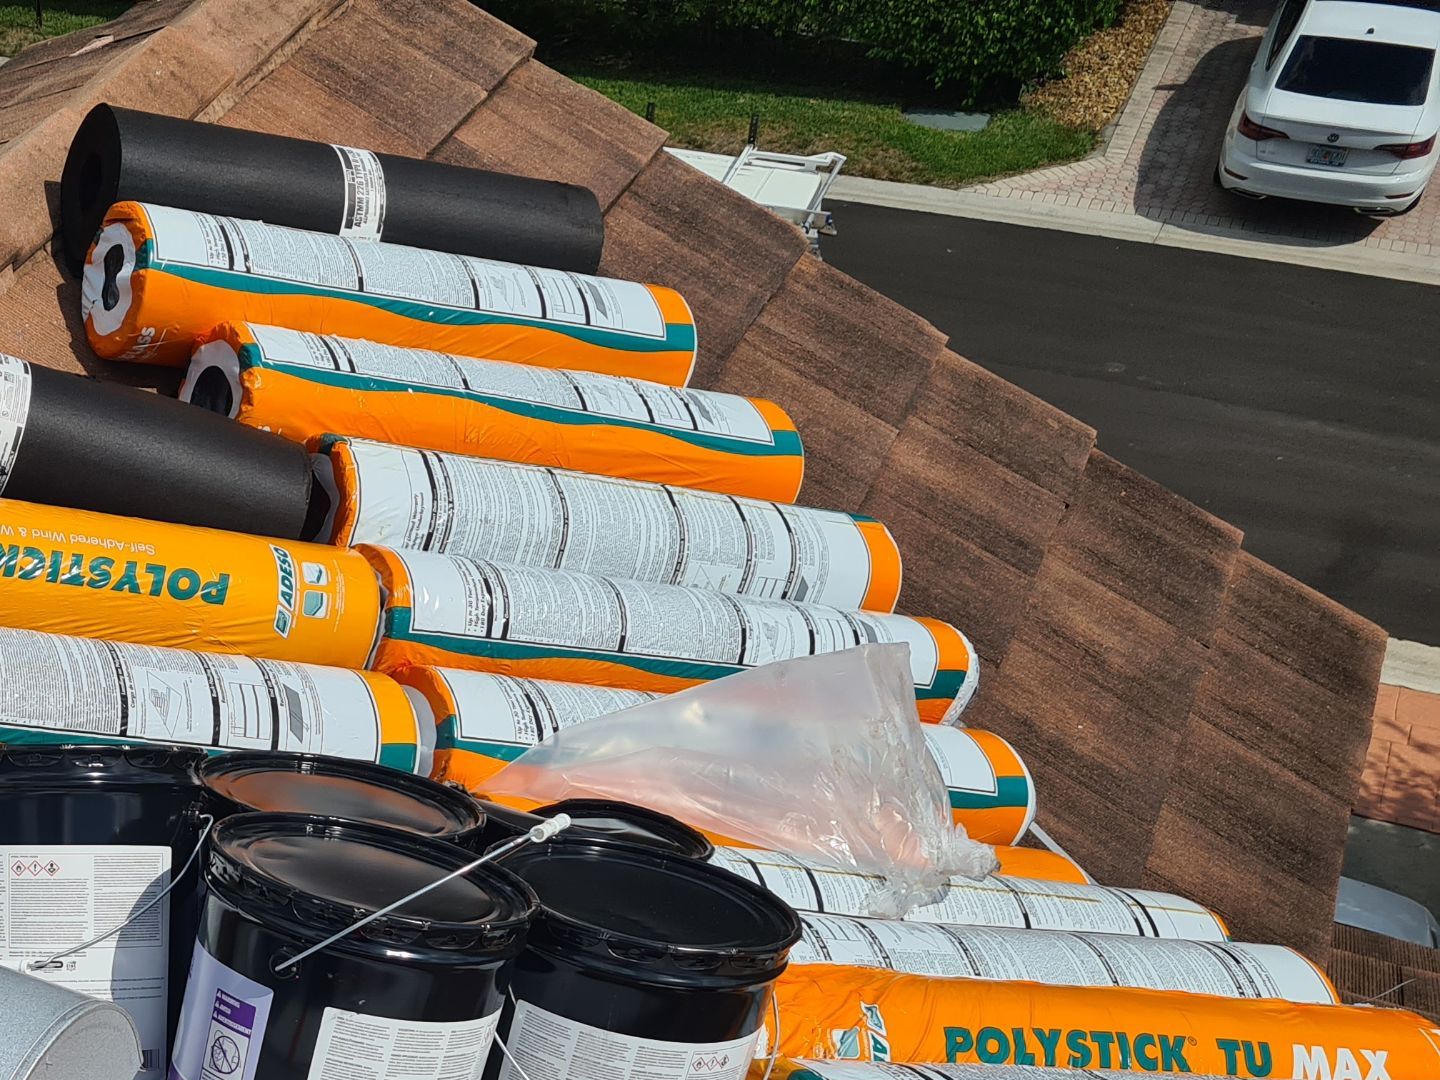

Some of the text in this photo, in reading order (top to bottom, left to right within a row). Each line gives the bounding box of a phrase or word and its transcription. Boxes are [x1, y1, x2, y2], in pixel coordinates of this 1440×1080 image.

[17, 526, 28, 538] &
[32, 528, 68, 545] Wind
[69, 533, 158, 556] Self-Adhered
[277, 545, 296, 607] ADESO
[943, 1026, 1188, 1074] POLYSTICK
[1215, 1037, 1273, 1077] TU
